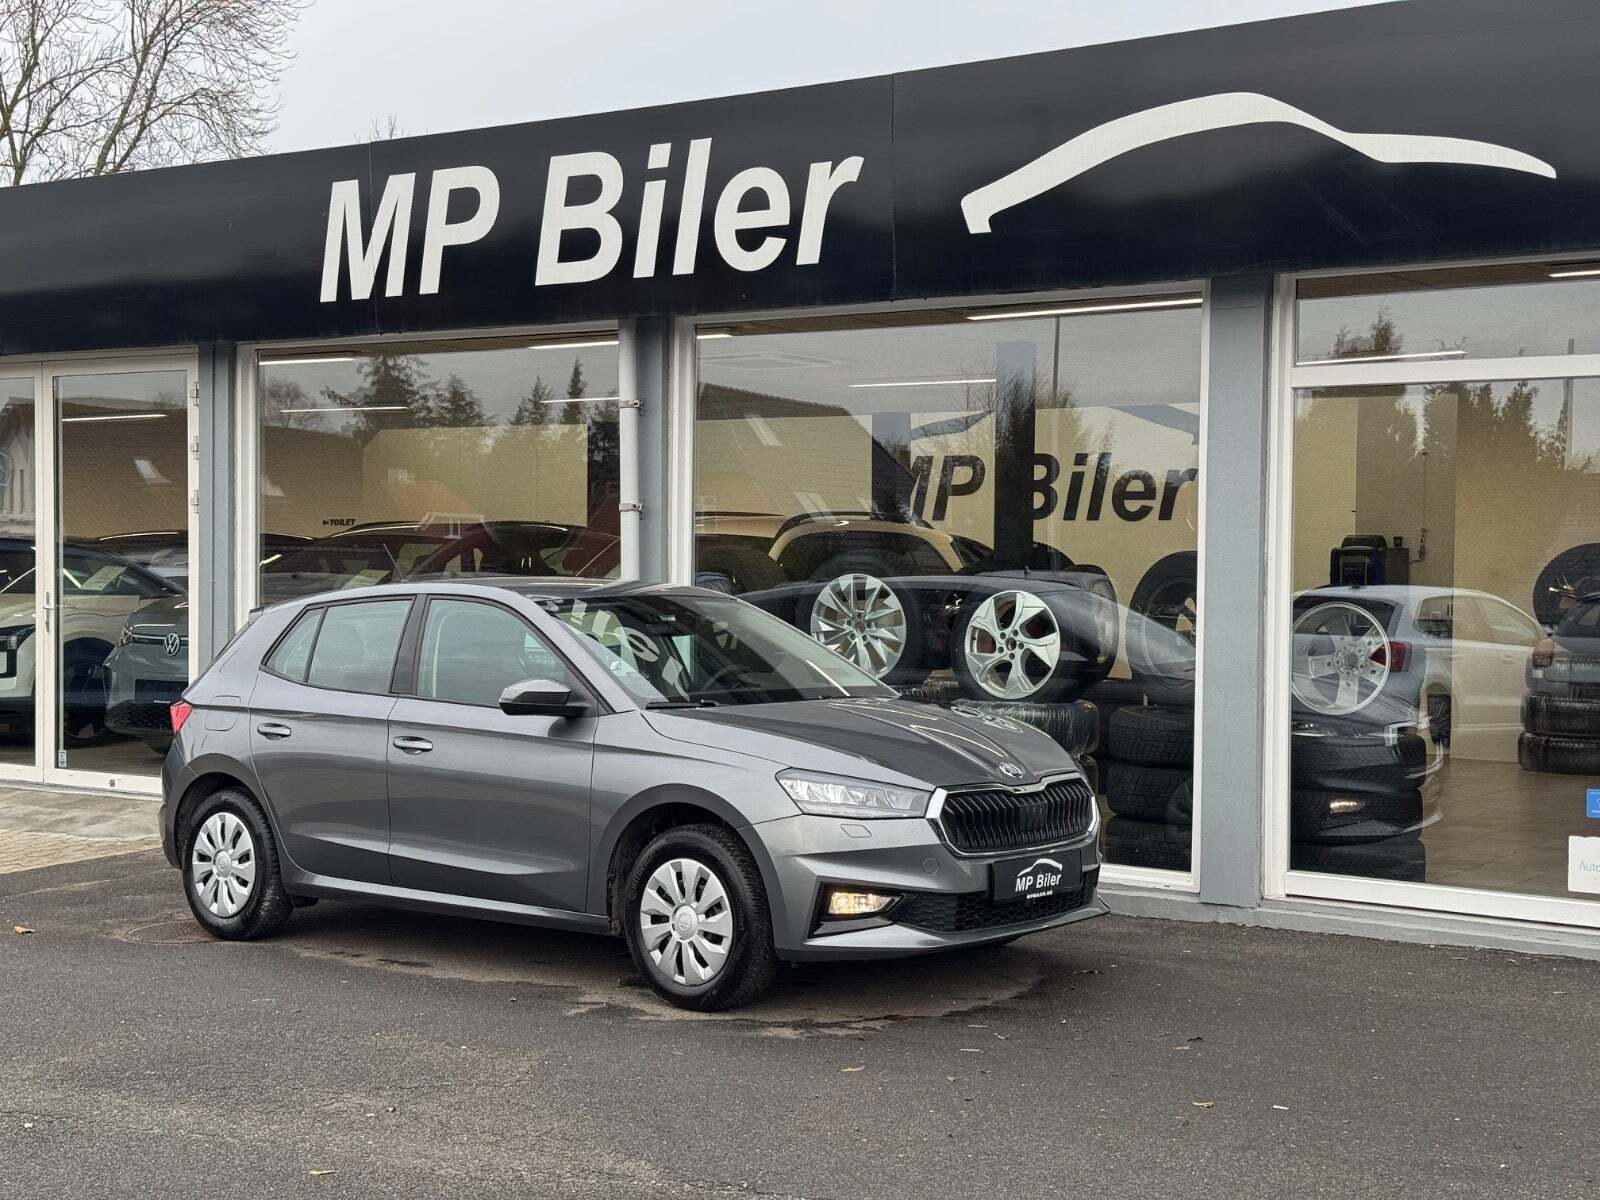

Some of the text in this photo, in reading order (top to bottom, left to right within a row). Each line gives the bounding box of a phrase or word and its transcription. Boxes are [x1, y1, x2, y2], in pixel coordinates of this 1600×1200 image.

[320, 137, 864, 303] MP Biler
[330, 518, 356, 526] TOILET
[1015, 873, 1062, 892] MP Biler
